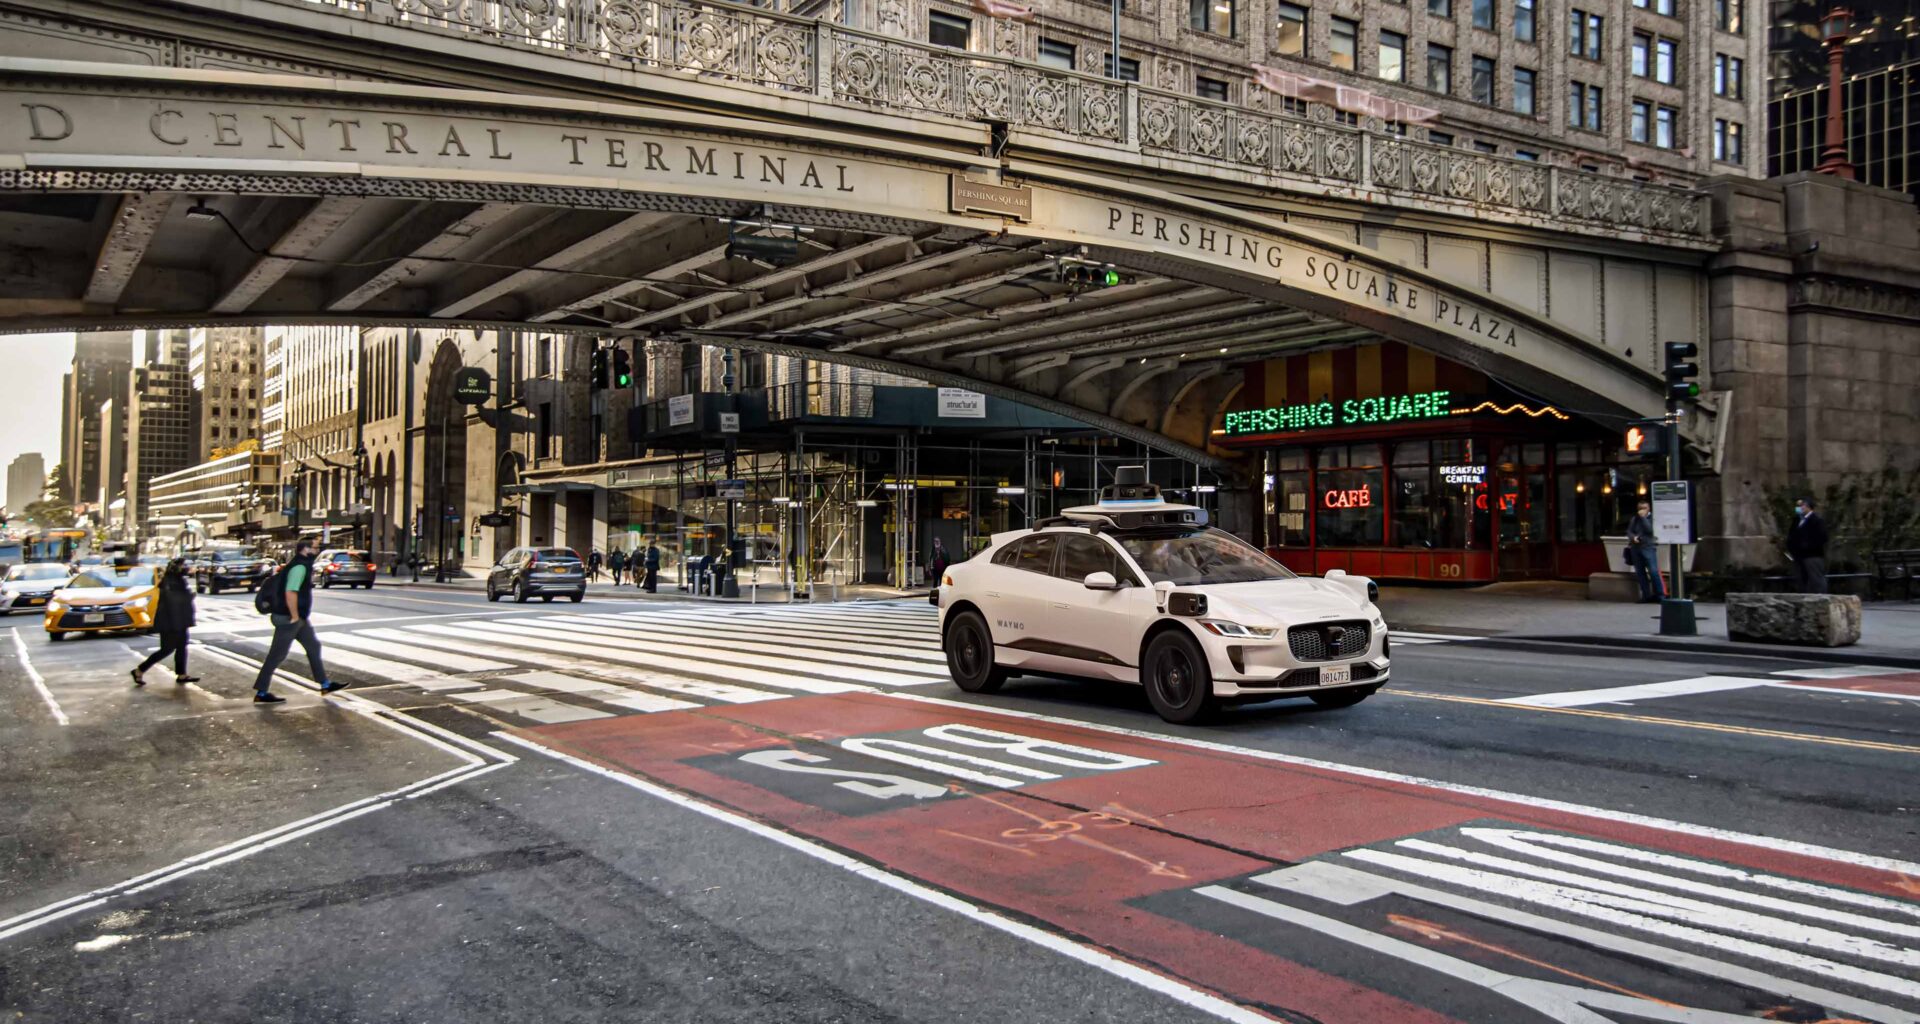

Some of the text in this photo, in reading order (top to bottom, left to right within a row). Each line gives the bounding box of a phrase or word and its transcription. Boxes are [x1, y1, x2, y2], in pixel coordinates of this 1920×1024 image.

[22, 103, 854, 193] D CENTRAL TERMINAL
[957, 188, 1028, 207] PERSHING SQUARE
[1107, 207, 1519, 348] PERSHING SQUARE PLAZA
[1226, 391, 1450, 434] PERSHING SQUARE
[1440, 466, 1486, 474] BREAKFAST
[1446, 475, 1482, 483] CENTRAL
[1325, 484, 1370, 508] CAFÉ
[1440, 564, 1460, 577] 90
[997, 619, 1024, 630] WAYMO
[739, 723, 1159, 798] BUS
